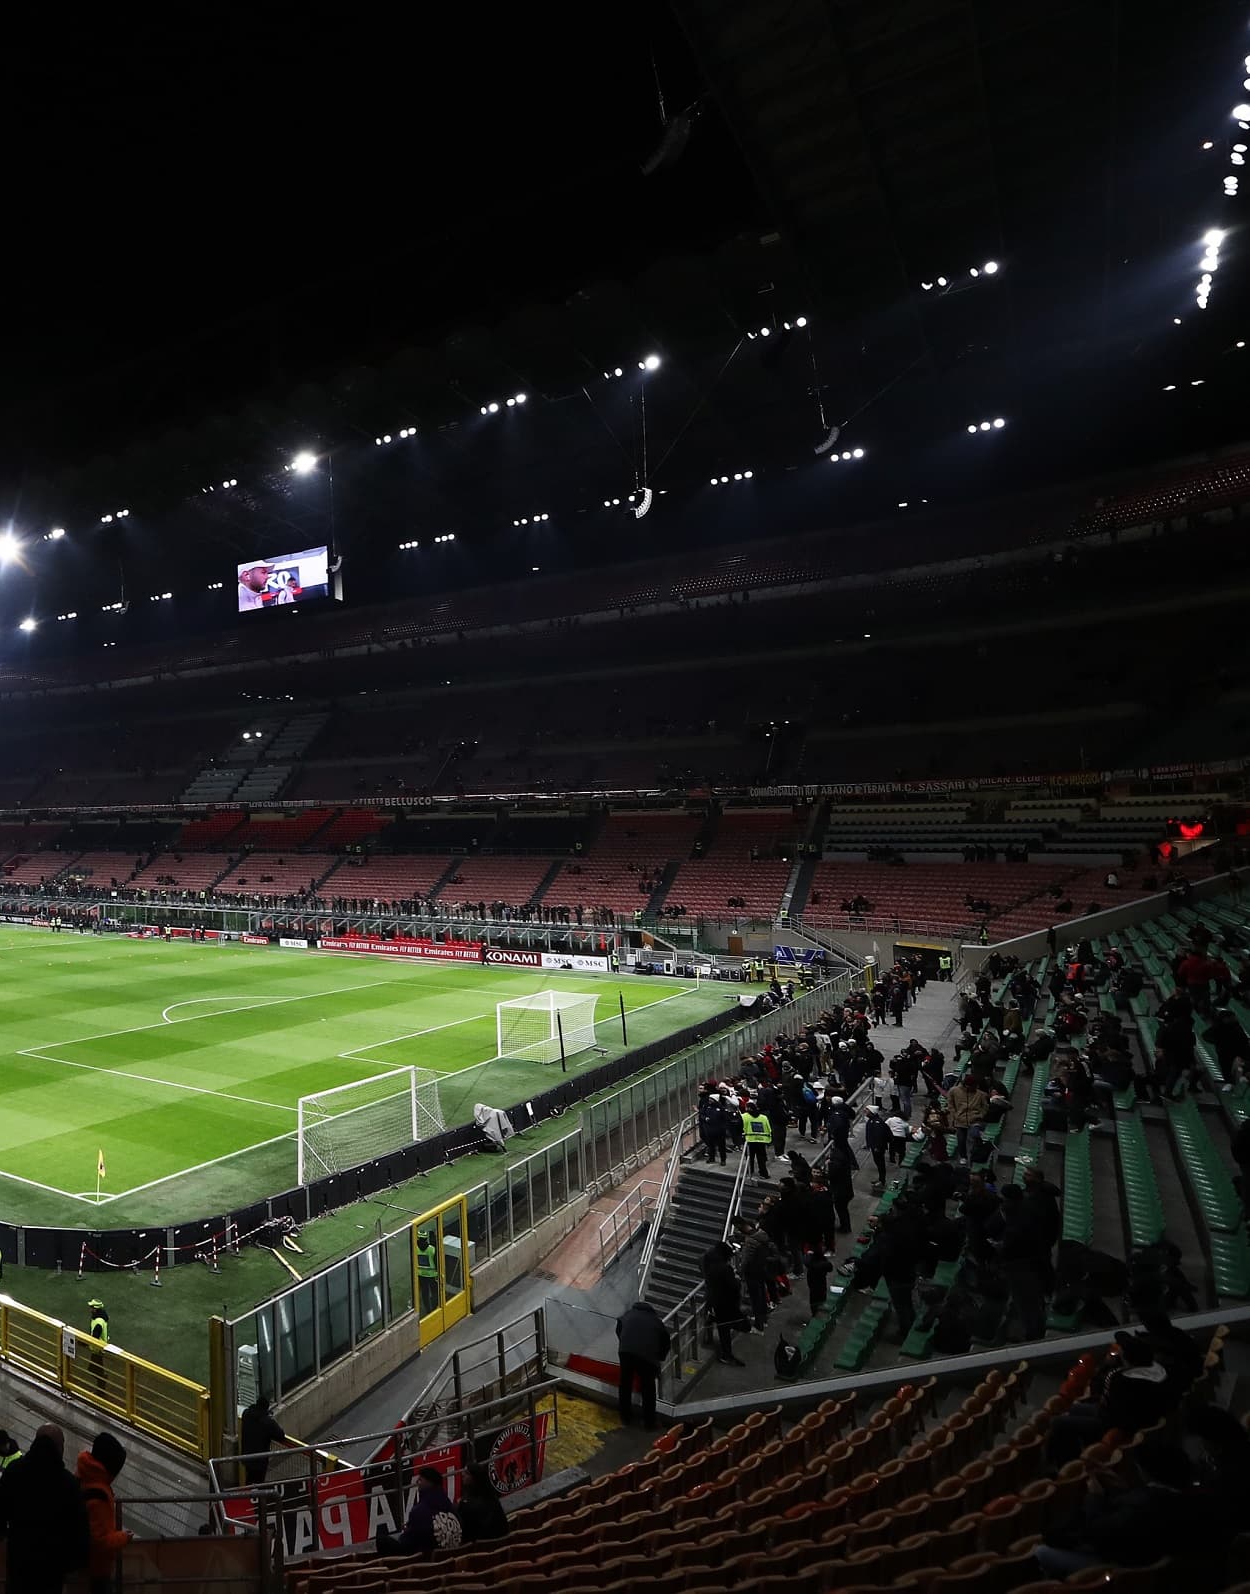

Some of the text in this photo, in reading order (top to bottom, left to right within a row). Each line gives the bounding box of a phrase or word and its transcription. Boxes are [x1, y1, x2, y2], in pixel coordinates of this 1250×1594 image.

[821, 785, 853, 796] ABANO
[918, 780, 966, 792] SASSARI
[385, 797, 432, 806] BELLUSCO
[371, 943, 399, 952] Emirates
[424, 947, 453, 957] Emirates
[486, 952, 537, 964] KONAMI
[585, 960, 604, 968] MSC
